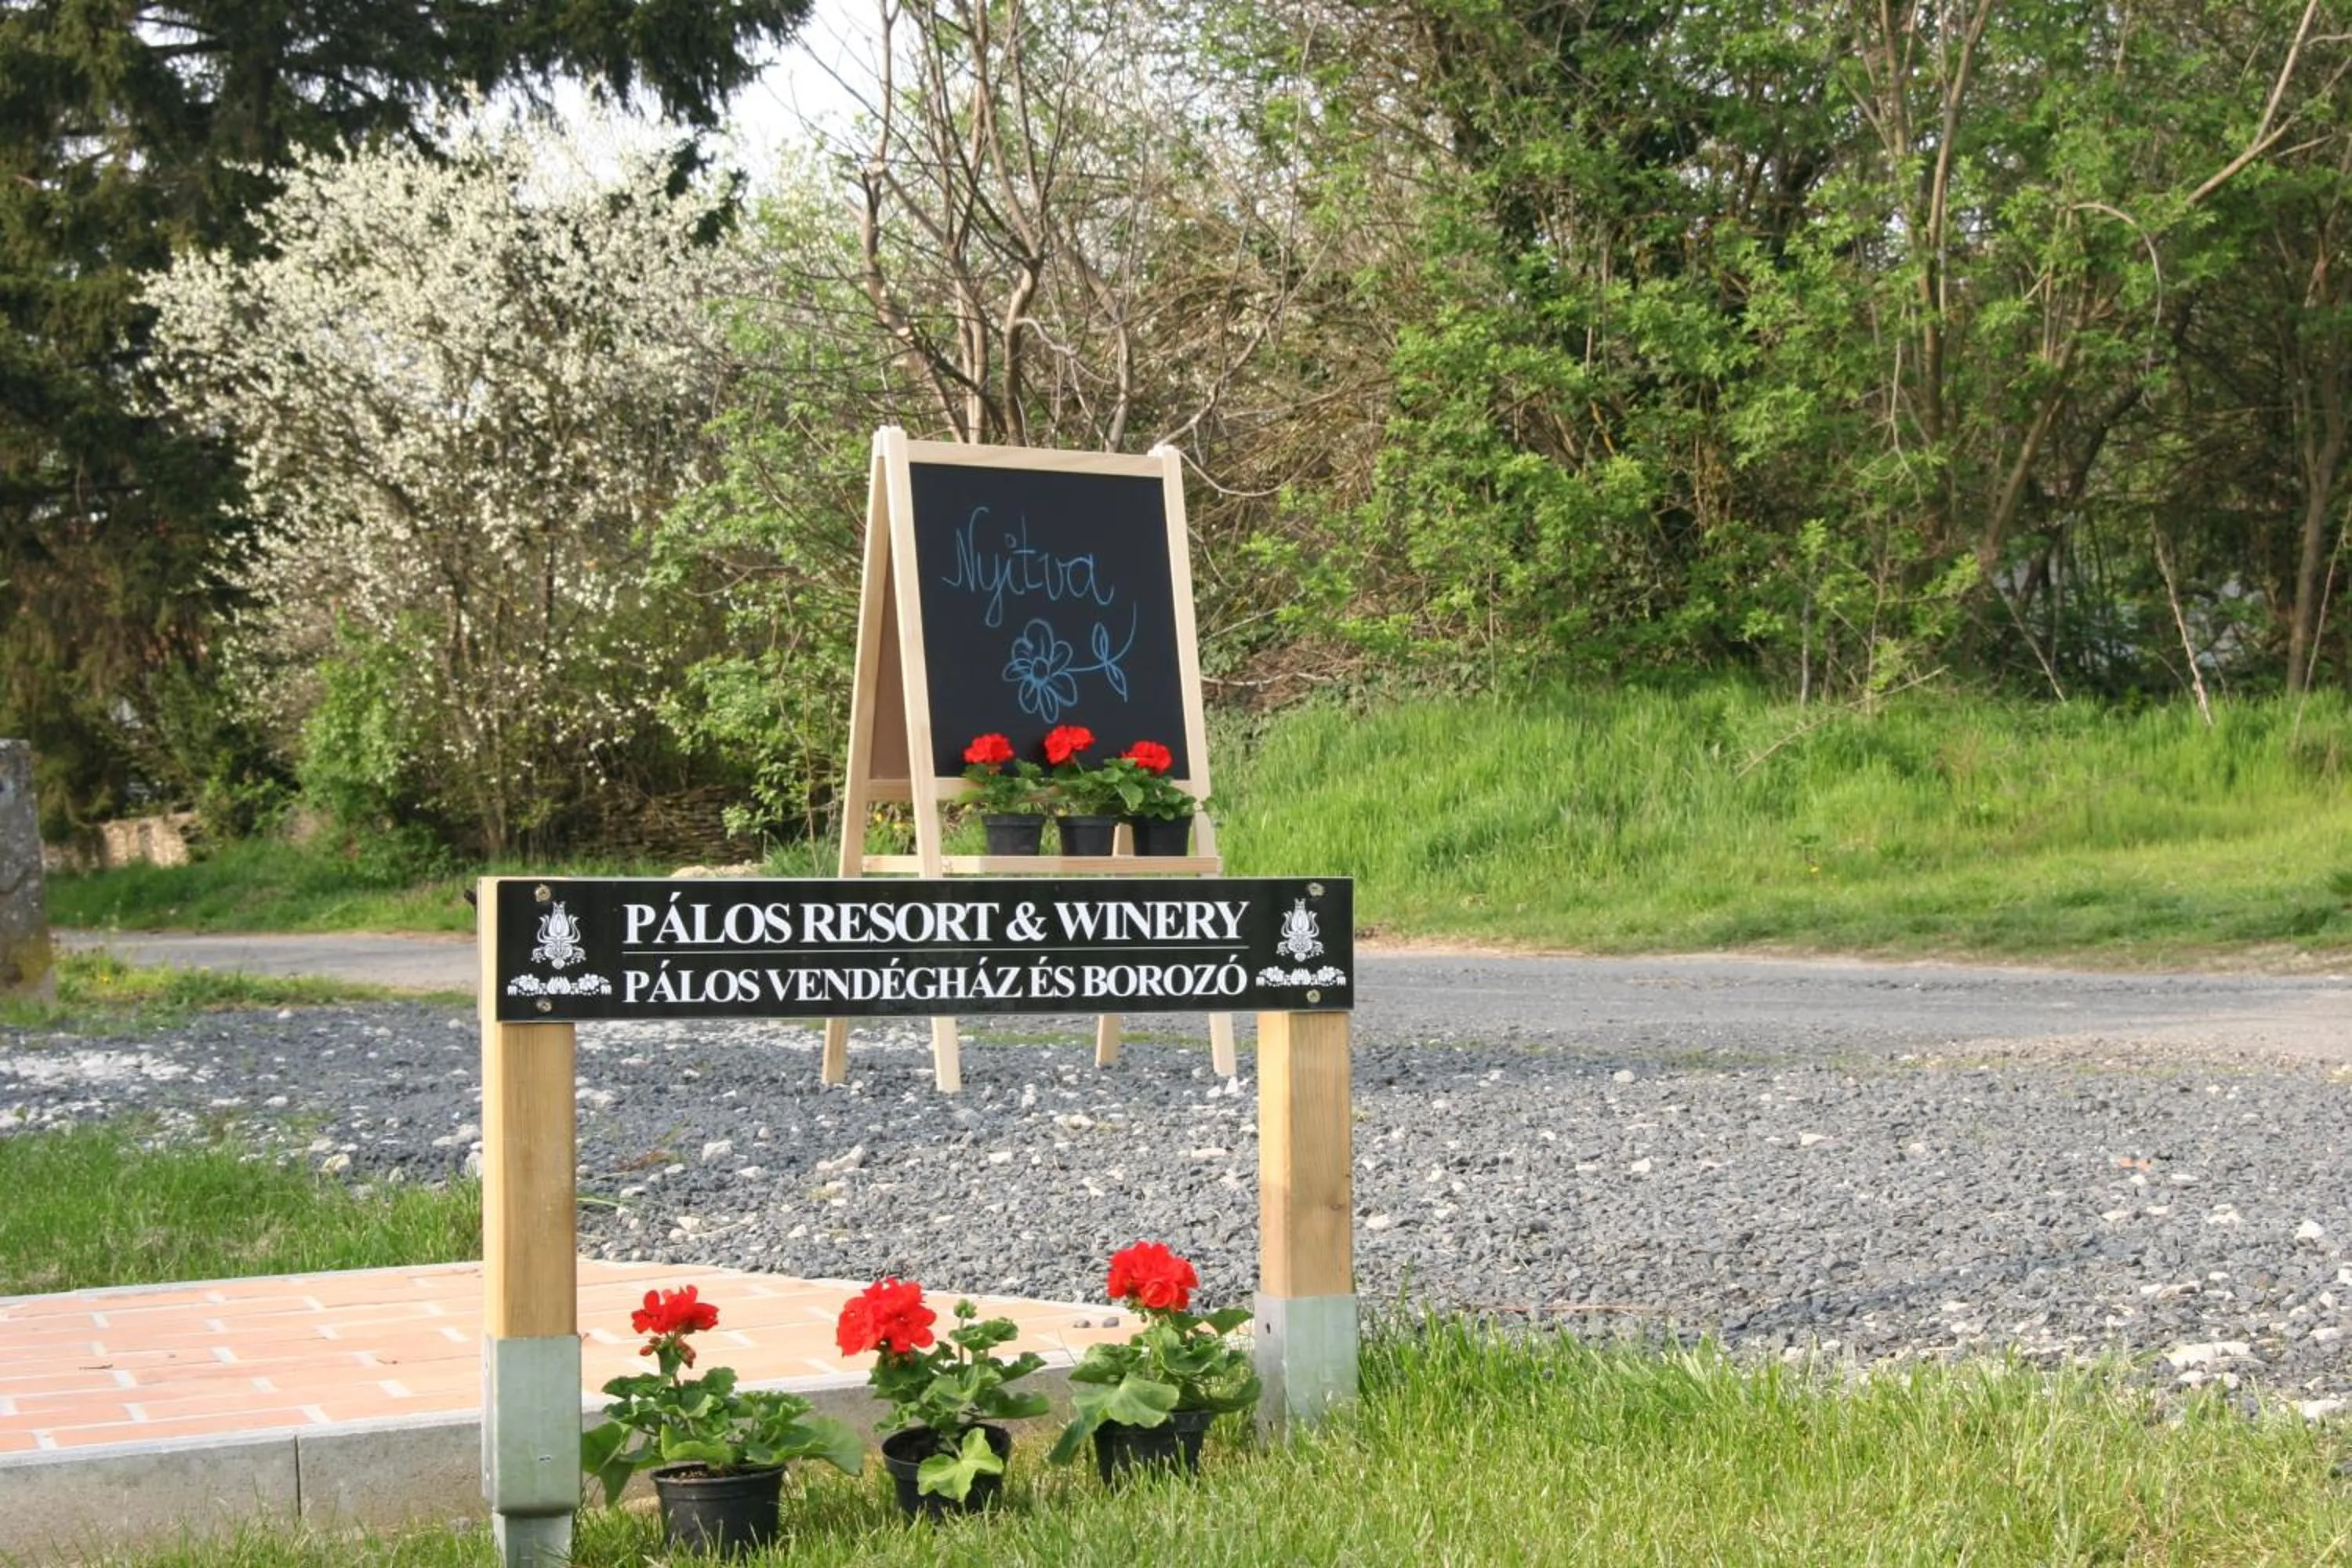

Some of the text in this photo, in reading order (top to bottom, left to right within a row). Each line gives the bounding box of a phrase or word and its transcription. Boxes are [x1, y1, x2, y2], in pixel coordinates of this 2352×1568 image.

[942, 506, 1115, 628] Nyitva
[622, 891, 1250, 944] PÁLOS RESORT & WINERY
[622, 953, 1248, 1004] PÁLOS VENDÉGHÁZ ÉS BOROZÓ
